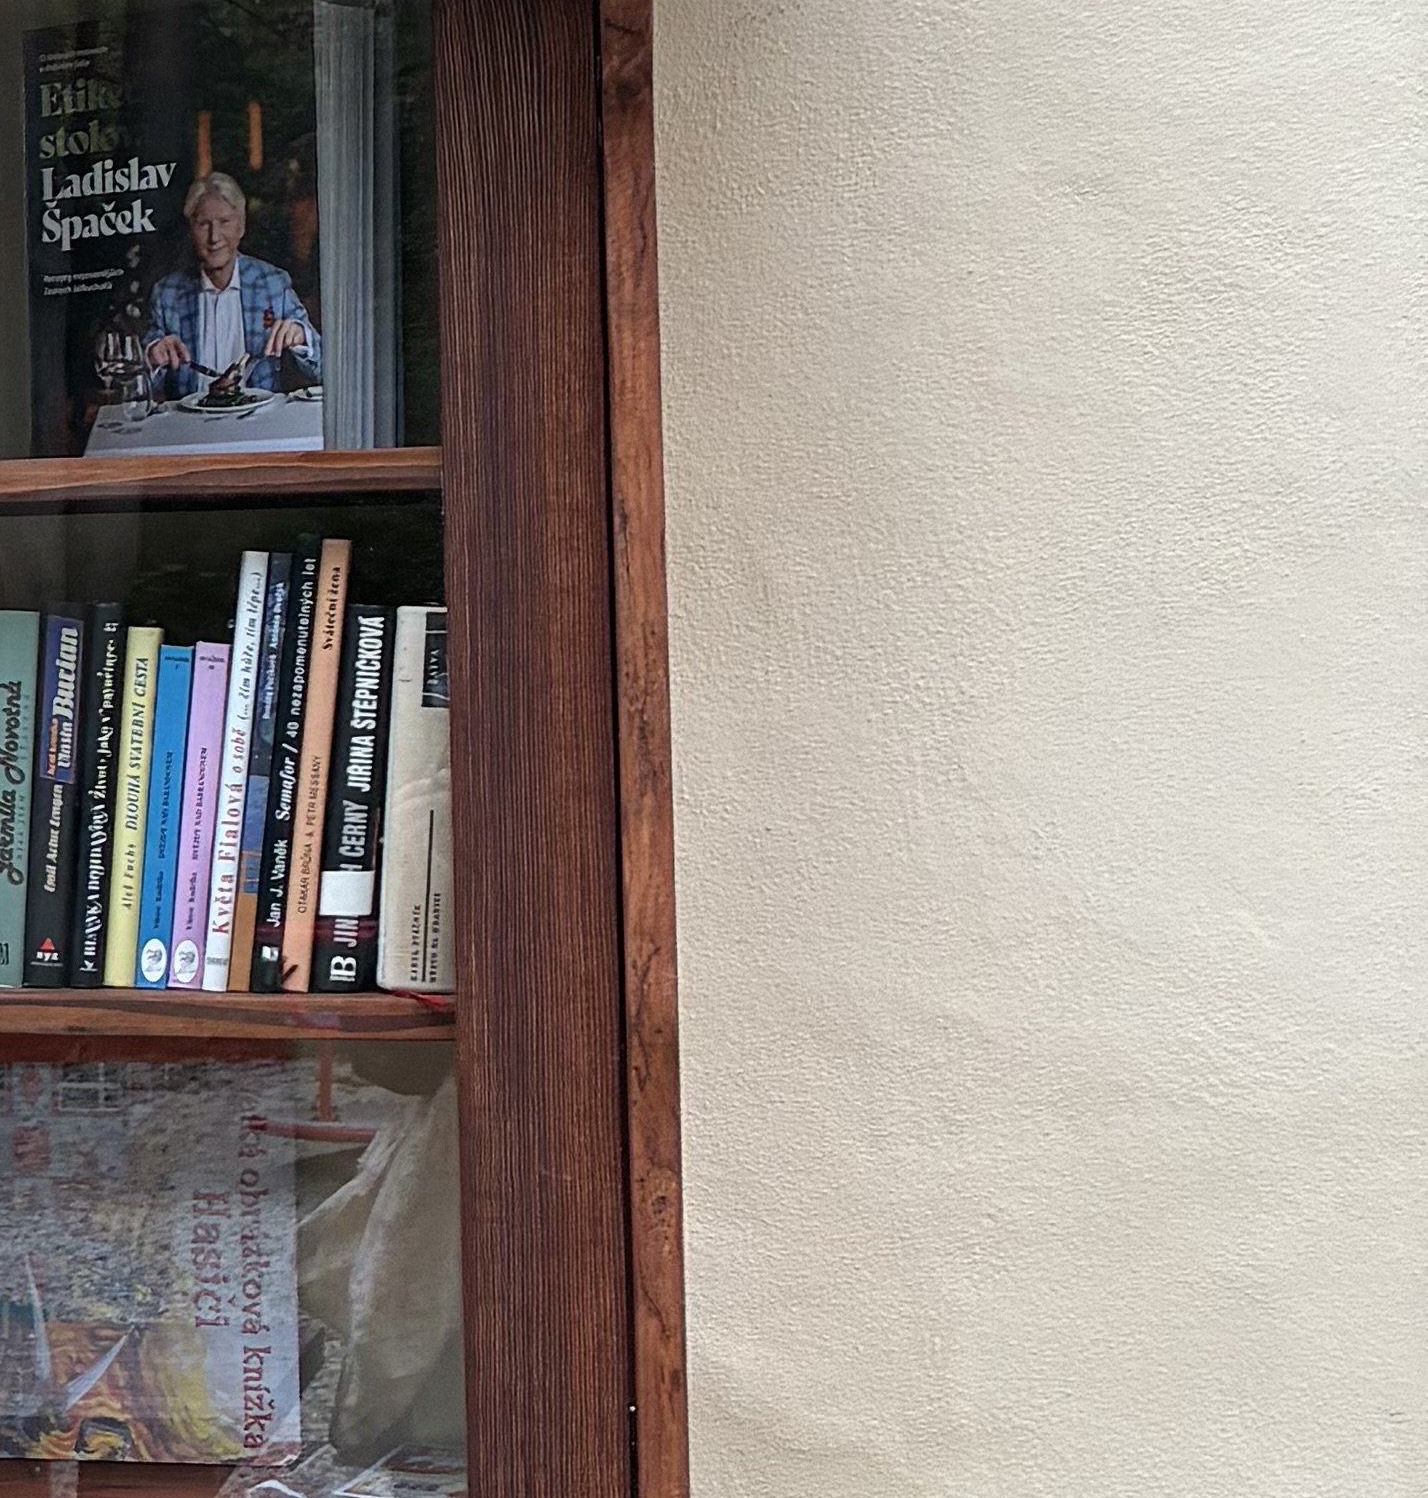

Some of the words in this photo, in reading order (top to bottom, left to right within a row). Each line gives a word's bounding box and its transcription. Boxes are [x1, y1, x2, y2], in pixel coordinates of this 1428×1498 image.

[41, 156, 177, 201] Ladislav
[42, 199, 156, 252] Špaček
[301, 558, 317, 576] let
[329, 566, 341, 596] žena
[243, 618, 257, 638] tím
[289, 581, 315, 716] nezapomenutelných
[321, 598, 339, 651] Sváteční
[50, 627, 79, 720] Burian
[134, 657, 148, 698] CESTA
[349, 615, 385, 730] ŠTĚPNIČKOVÁ
[57, 721, 73, 769] Vlasta
[128, 702, 146, 771] SVATEBNÍ
[230, 726, 247, 760] sobě
[286, 721, 300, 738] 40
[232, 765, 243, 774] o
[274, 756, 297, 821] Semafor
[347, 735, 376, 792] JIŘINA
[124, 773, 141, 831] DLOUHÁ
[217, 782, 243, 862] Fialová
[304, 802, 317, 827] PETR
[338, 799, 369, 857] ČERNÝ
[269, 838, 288, 881] Vaněk
[211, 873, 234, 935] Květa
[265, 902, 282, 928] Jan
[269, 884, 284, 898] J.
[296, 876, 311, 914] OTAKAR
[190, 1190, 234, 1328] Hasiči
[241, 1344, 275, 1449] knížka
